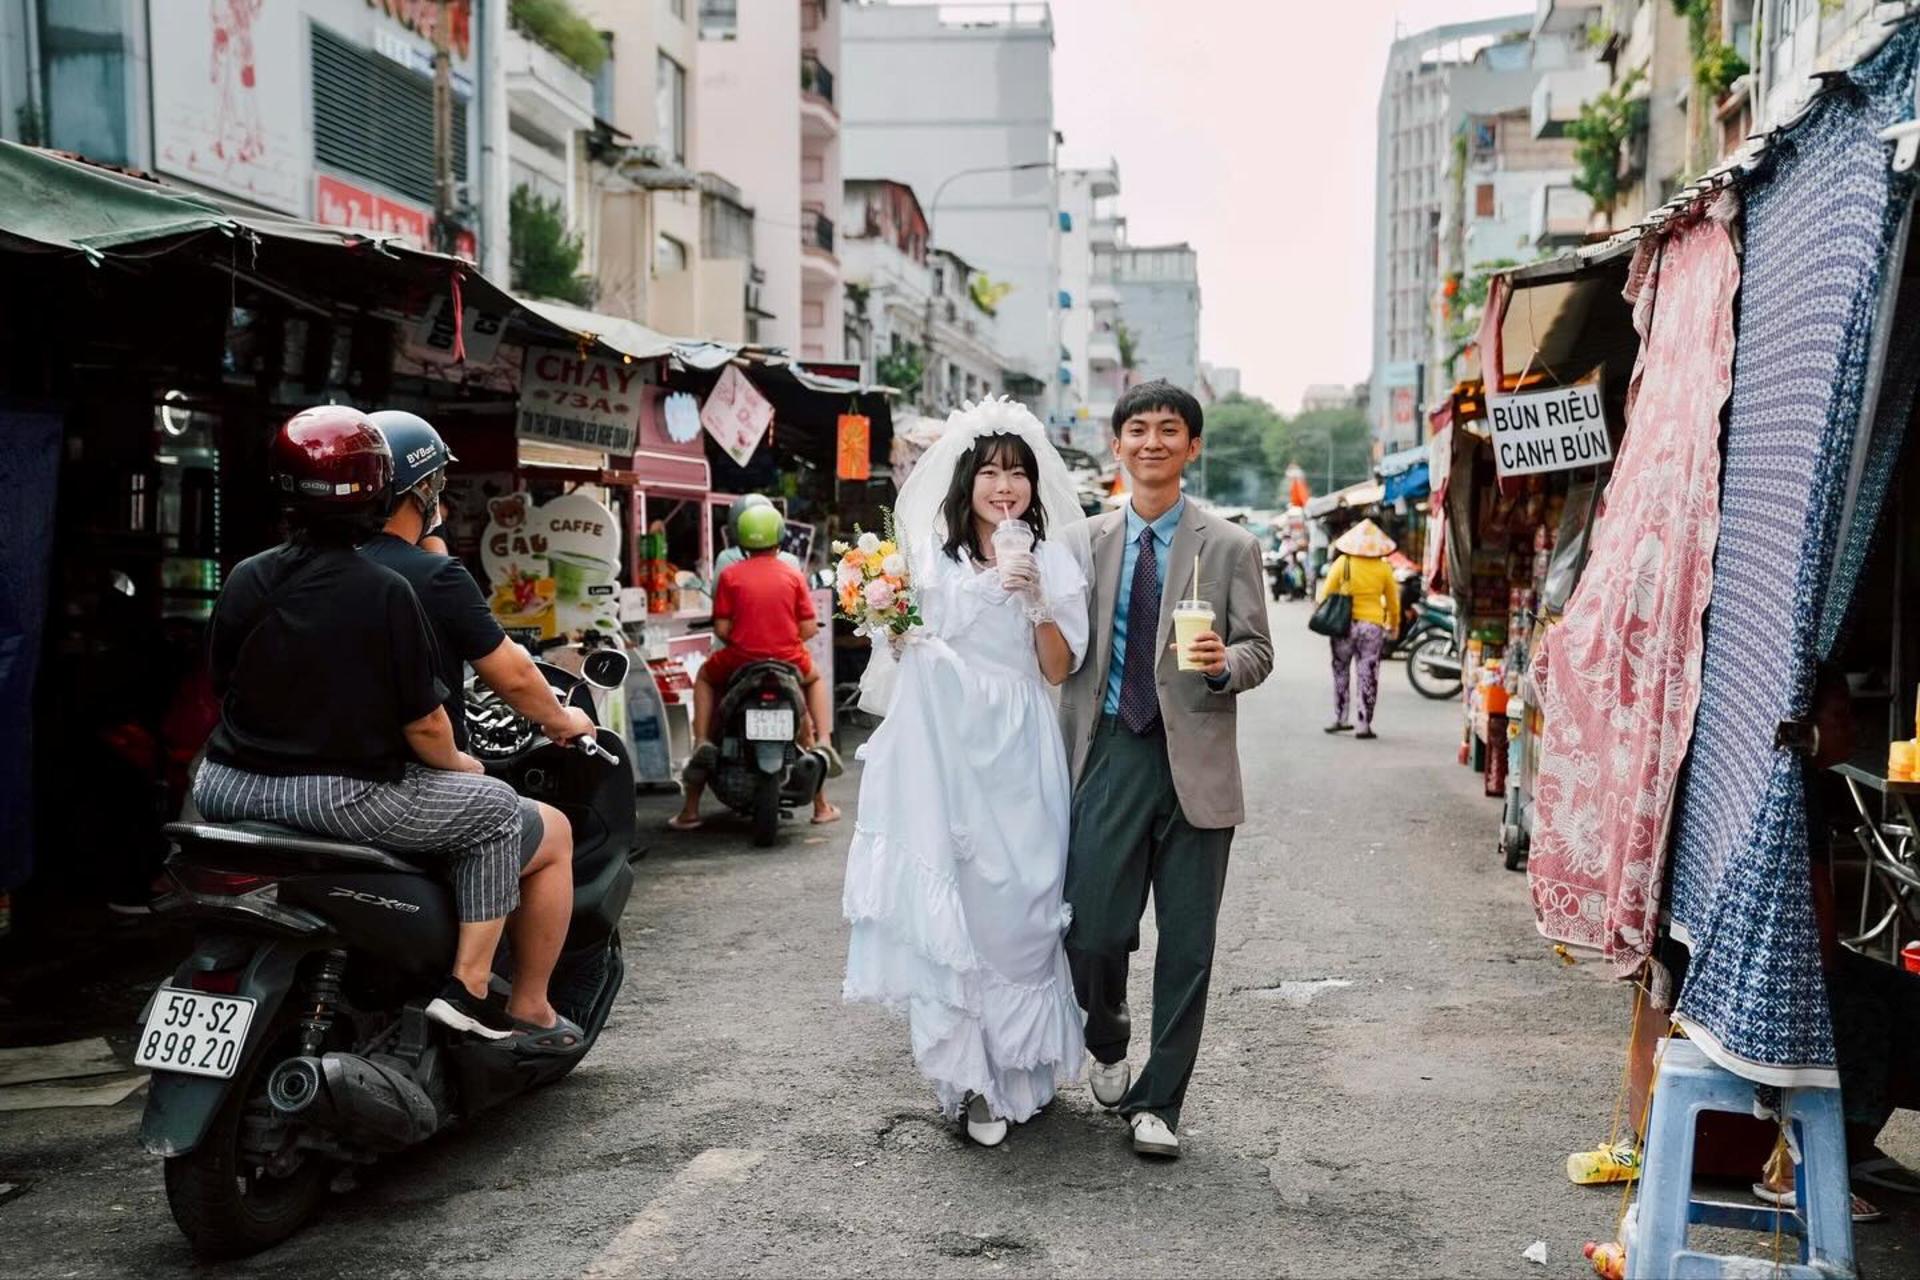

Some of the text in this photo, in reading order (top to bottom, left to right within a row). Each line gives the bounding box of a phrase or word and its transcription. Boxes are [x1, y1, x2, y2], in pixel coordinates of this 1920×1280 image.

[535, 354, 638, 394] CHAY
[554, 390, 611, 414] 73A
[1493, 390, 1600, 432] BÚN RIÊU
[1500, 425, 1607, 469] CANH BÚN
[550, 519, 603, 537] CAFFE
[164, 995, 238, 1034] 59-S2
[143, 1030, 236, 1070] 898.20
